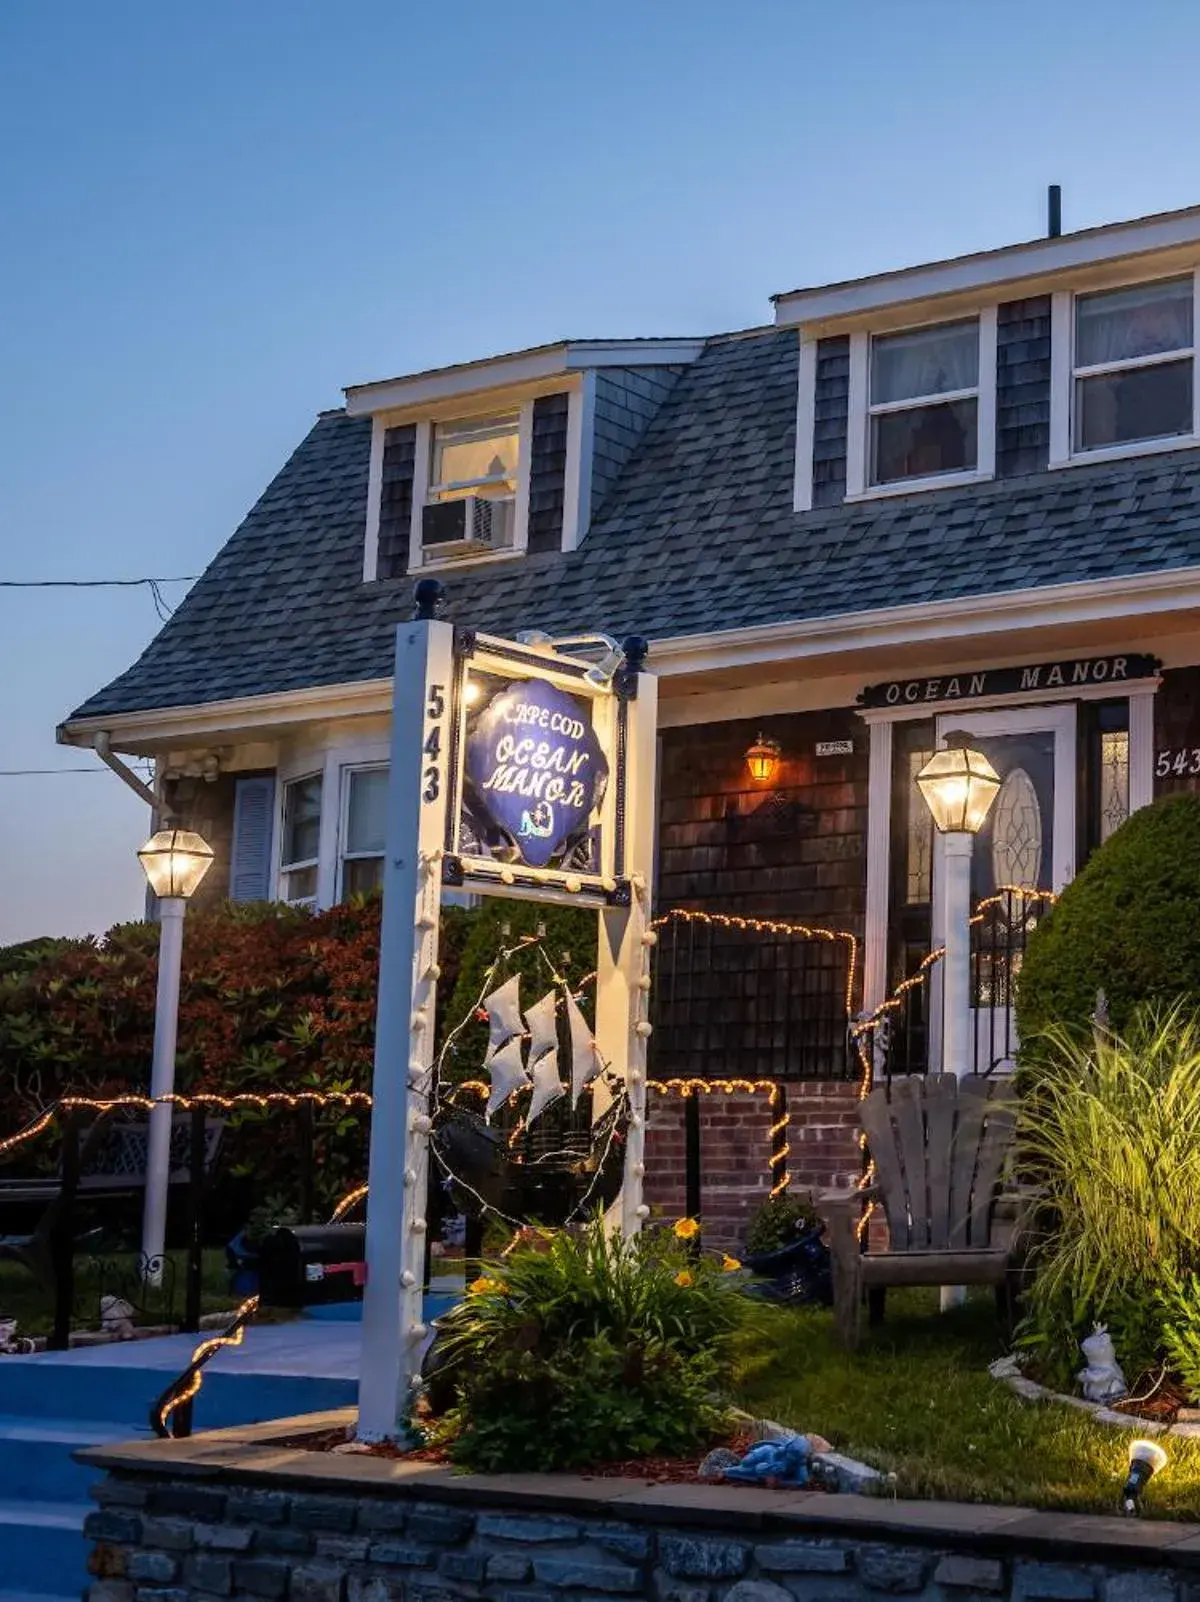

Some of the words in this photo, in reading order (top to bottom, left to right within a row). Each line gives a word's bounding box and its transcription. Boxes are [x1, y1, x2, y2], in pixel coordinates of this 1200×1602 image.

[886, 673, 986, 704] OCEAN
[1020, 657, 1128, 689] MANOR
[503, 703, 549, 728] CAPE
[551, 713, 585, 740] COD
[422, 684, 444, 804] 543
[495, 734, 590, 775] OCEAN
[482, 764, 585, 808] MANOR
